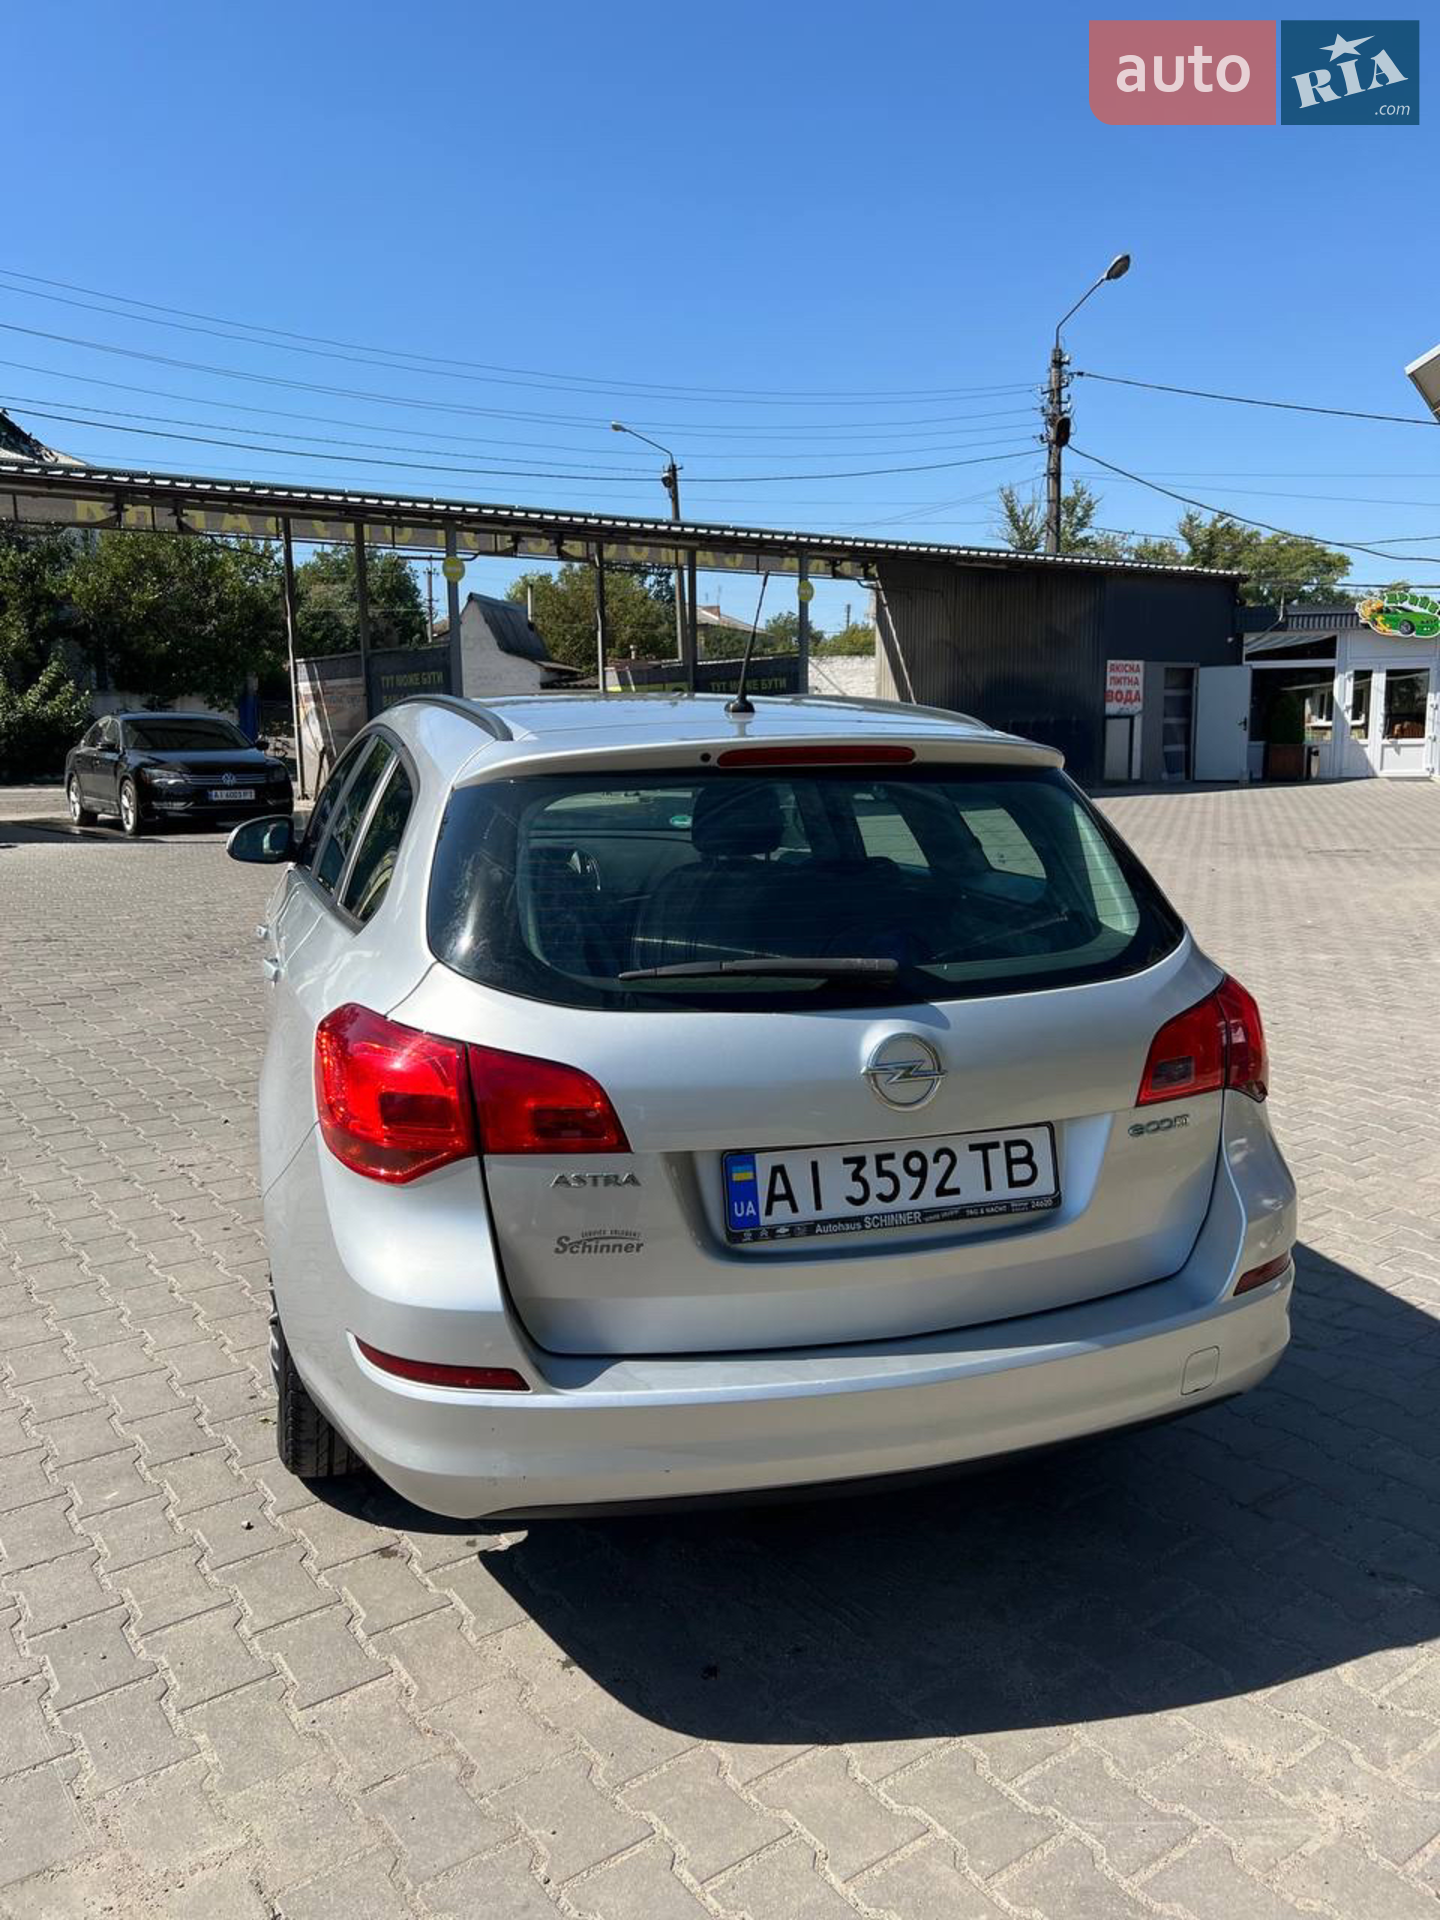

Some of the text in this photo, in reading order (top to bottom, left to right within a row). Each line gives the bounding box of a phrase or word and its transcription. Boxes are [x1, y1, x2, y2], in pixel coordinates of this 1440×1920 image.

[1109, 663, 1141, 672] ЯКІСНА
[1109, 676, 1140, 686] ПИТНА
[1104, 690, 1141, 704] ВОДА
[550, 1172, 641, 1188] ASTRA
[764, 1138, 1039, 1217] AI 3592 TB
[734, 1200, 757, 1218] UA
[815, 1221, 862, 1235] Autohaus
[864, 1212, 922, 1230] SCHINNER
[554, 1235, 644, 1254] Schinner
